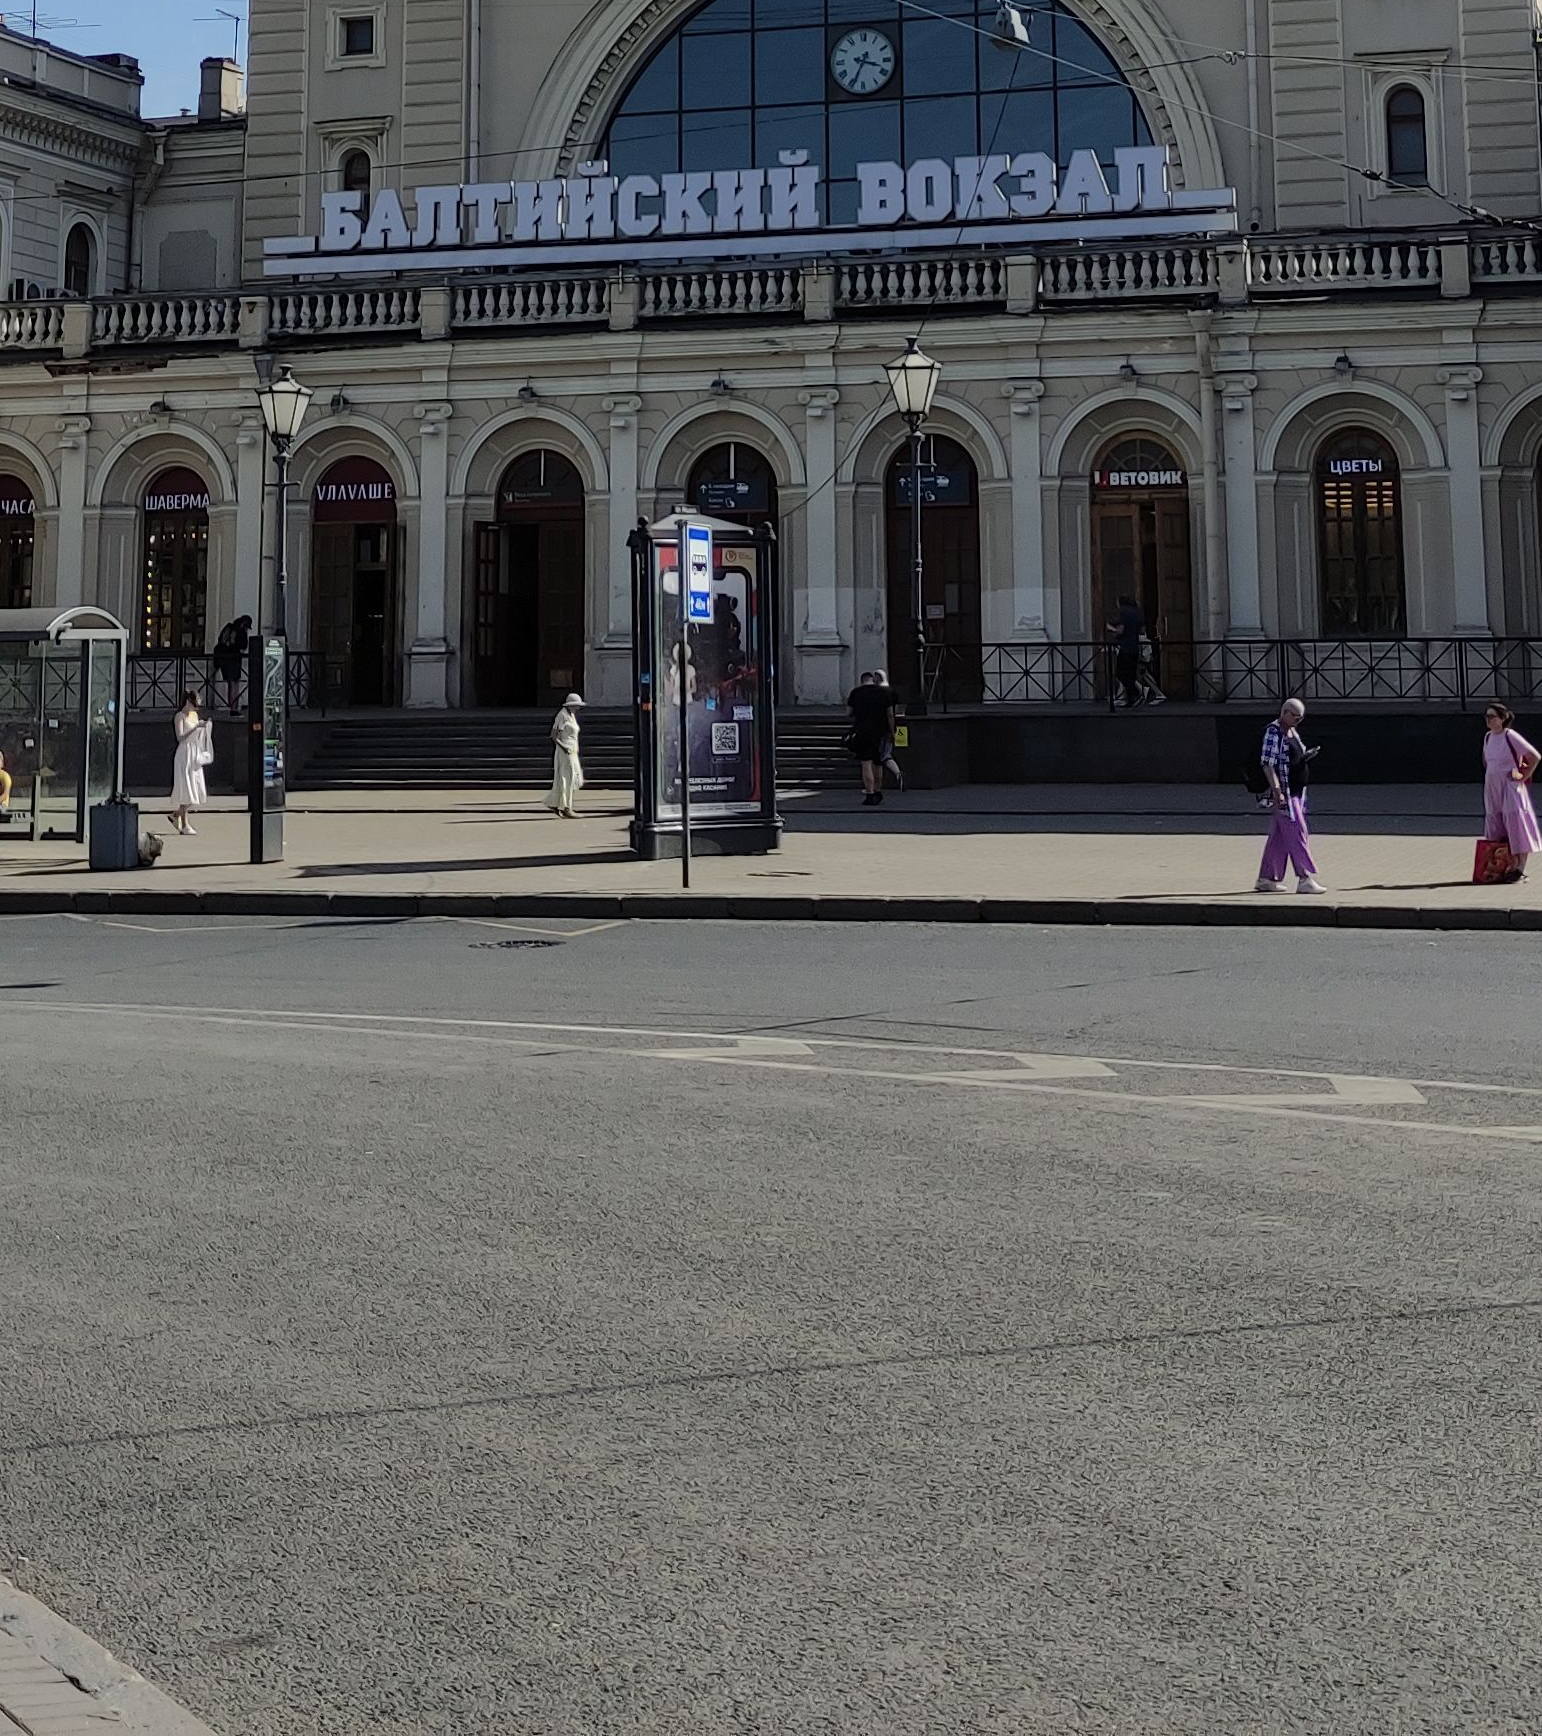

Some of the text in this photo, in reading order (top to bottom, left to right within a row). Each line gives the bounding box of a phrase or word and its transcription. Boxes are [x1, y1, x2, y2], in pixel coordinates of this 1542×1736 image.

[319, 144, 1171, 252] БАЛТИЙСКИЙ ВОКЗАЛ
[1330, 459, 1382, 475] ЦВЕТЫ
[145, 493, 209, 511] ШАВЕРМА
